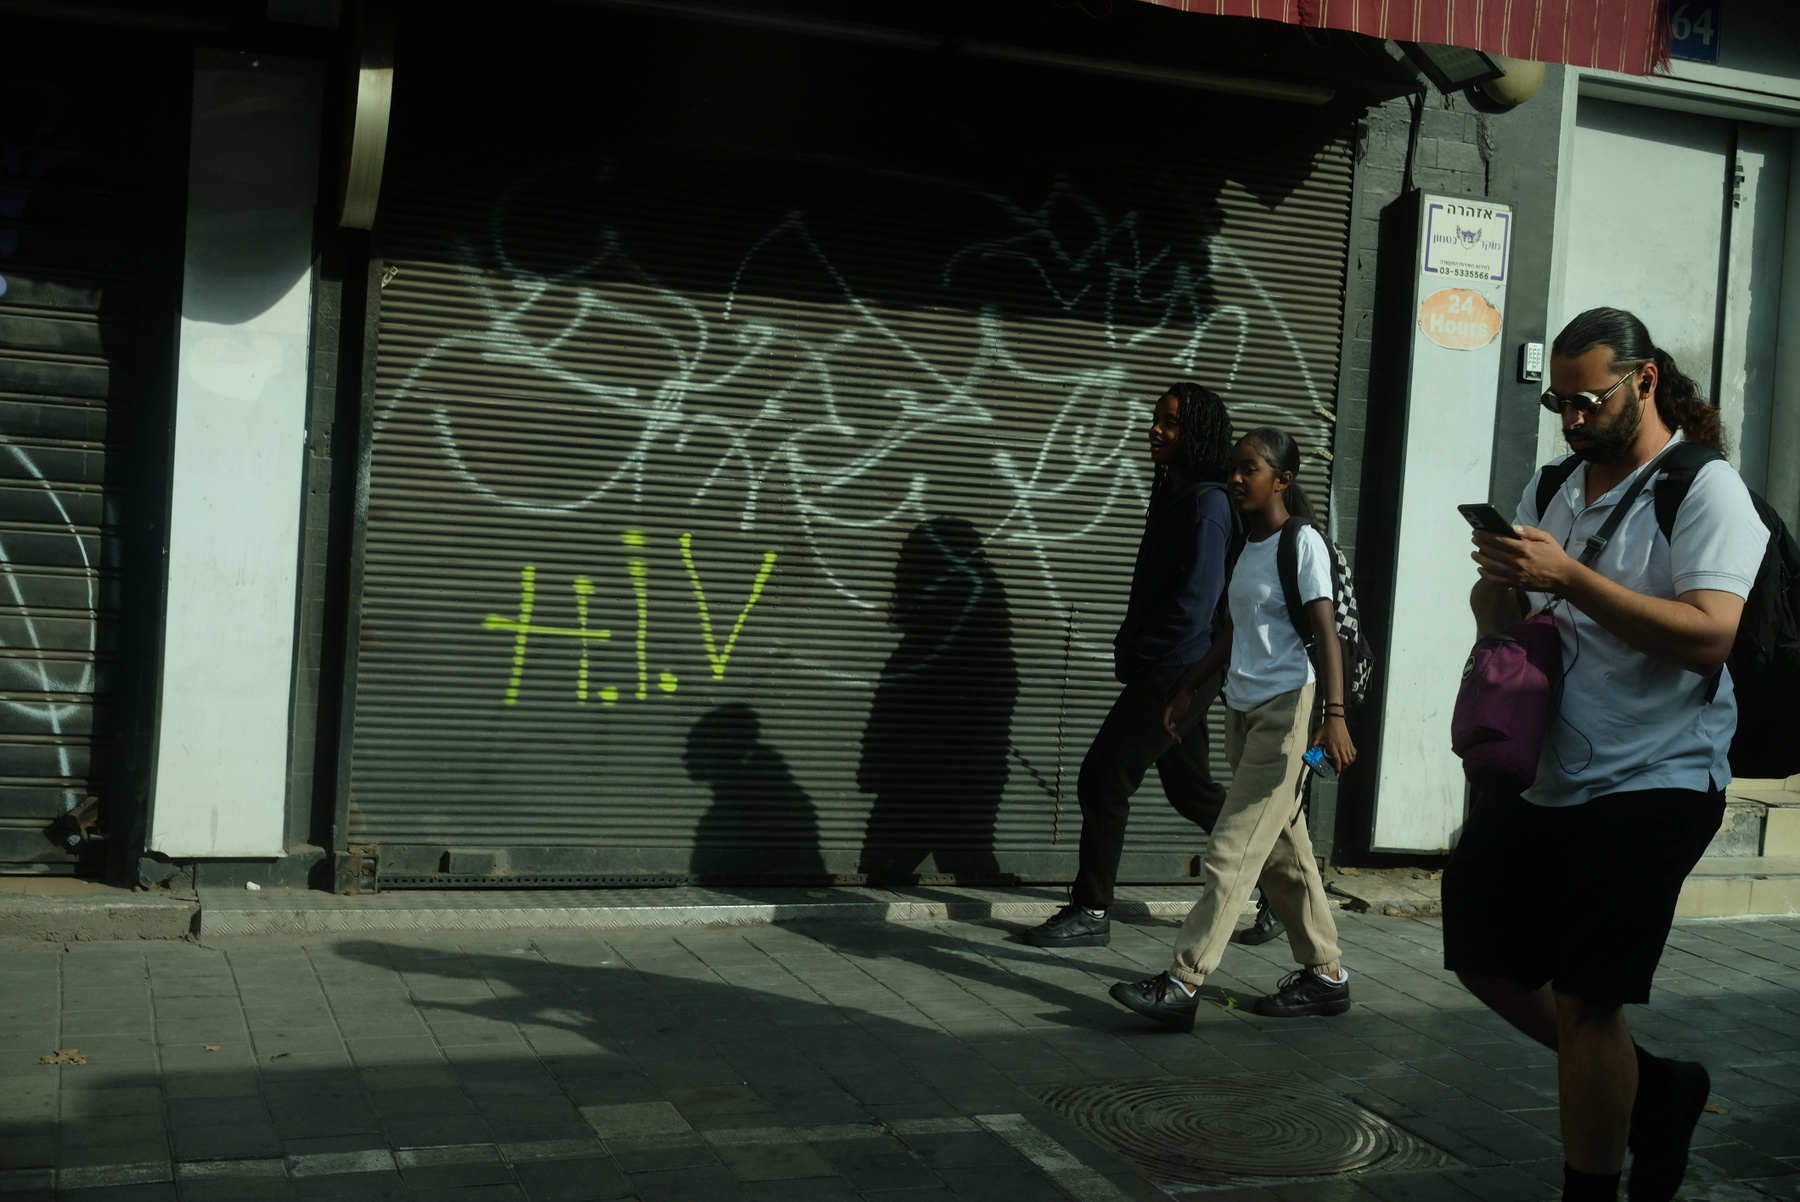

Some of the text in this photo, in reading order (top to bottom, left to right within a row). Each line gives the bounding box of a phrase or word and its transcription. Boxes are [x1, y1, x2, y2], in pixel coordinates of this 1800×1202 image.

[1671, 3, 1715, 46] 64
[1447, 203, 1493, 220] אזהרה
[1439, 266, 1489, 280] 03-5335566
[1447, 293, 1474, 315] 24
[1429, 312, 1489, 338] Hours
